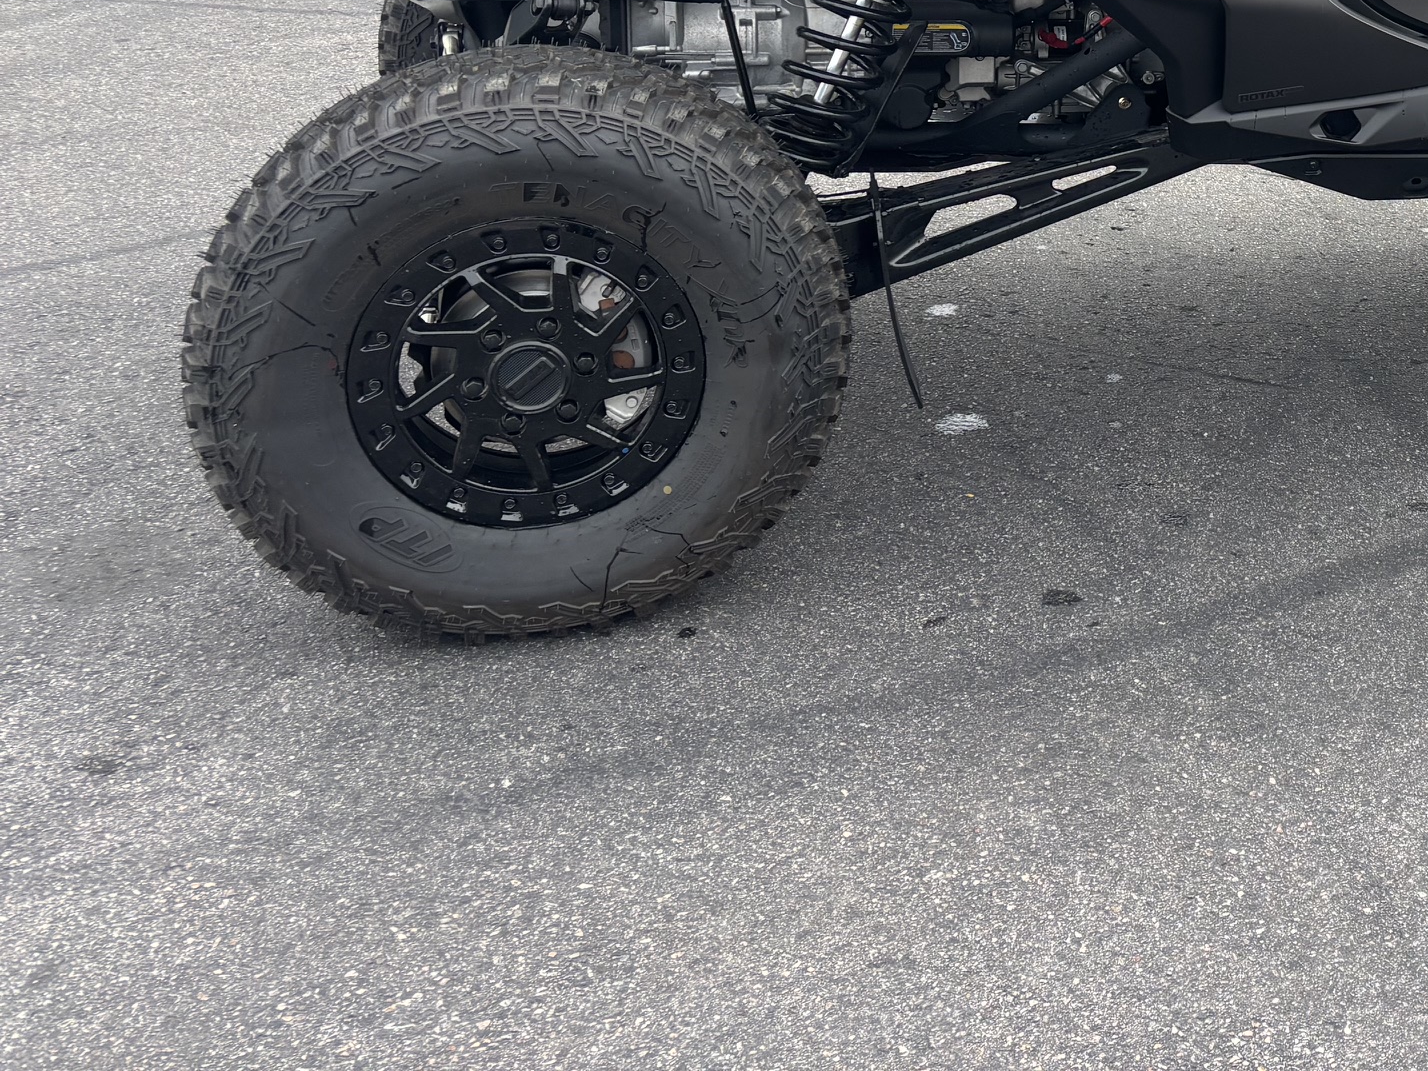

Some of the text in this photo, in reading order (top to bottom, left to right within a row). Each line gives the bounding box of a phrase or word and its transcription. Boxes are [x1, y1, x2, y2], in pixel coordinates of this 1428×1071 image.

[1238, 89, 1285, 104] ROTAX
[488, 181, 721, 270] TENACITY
[358, 516, 456, 567] ITP
